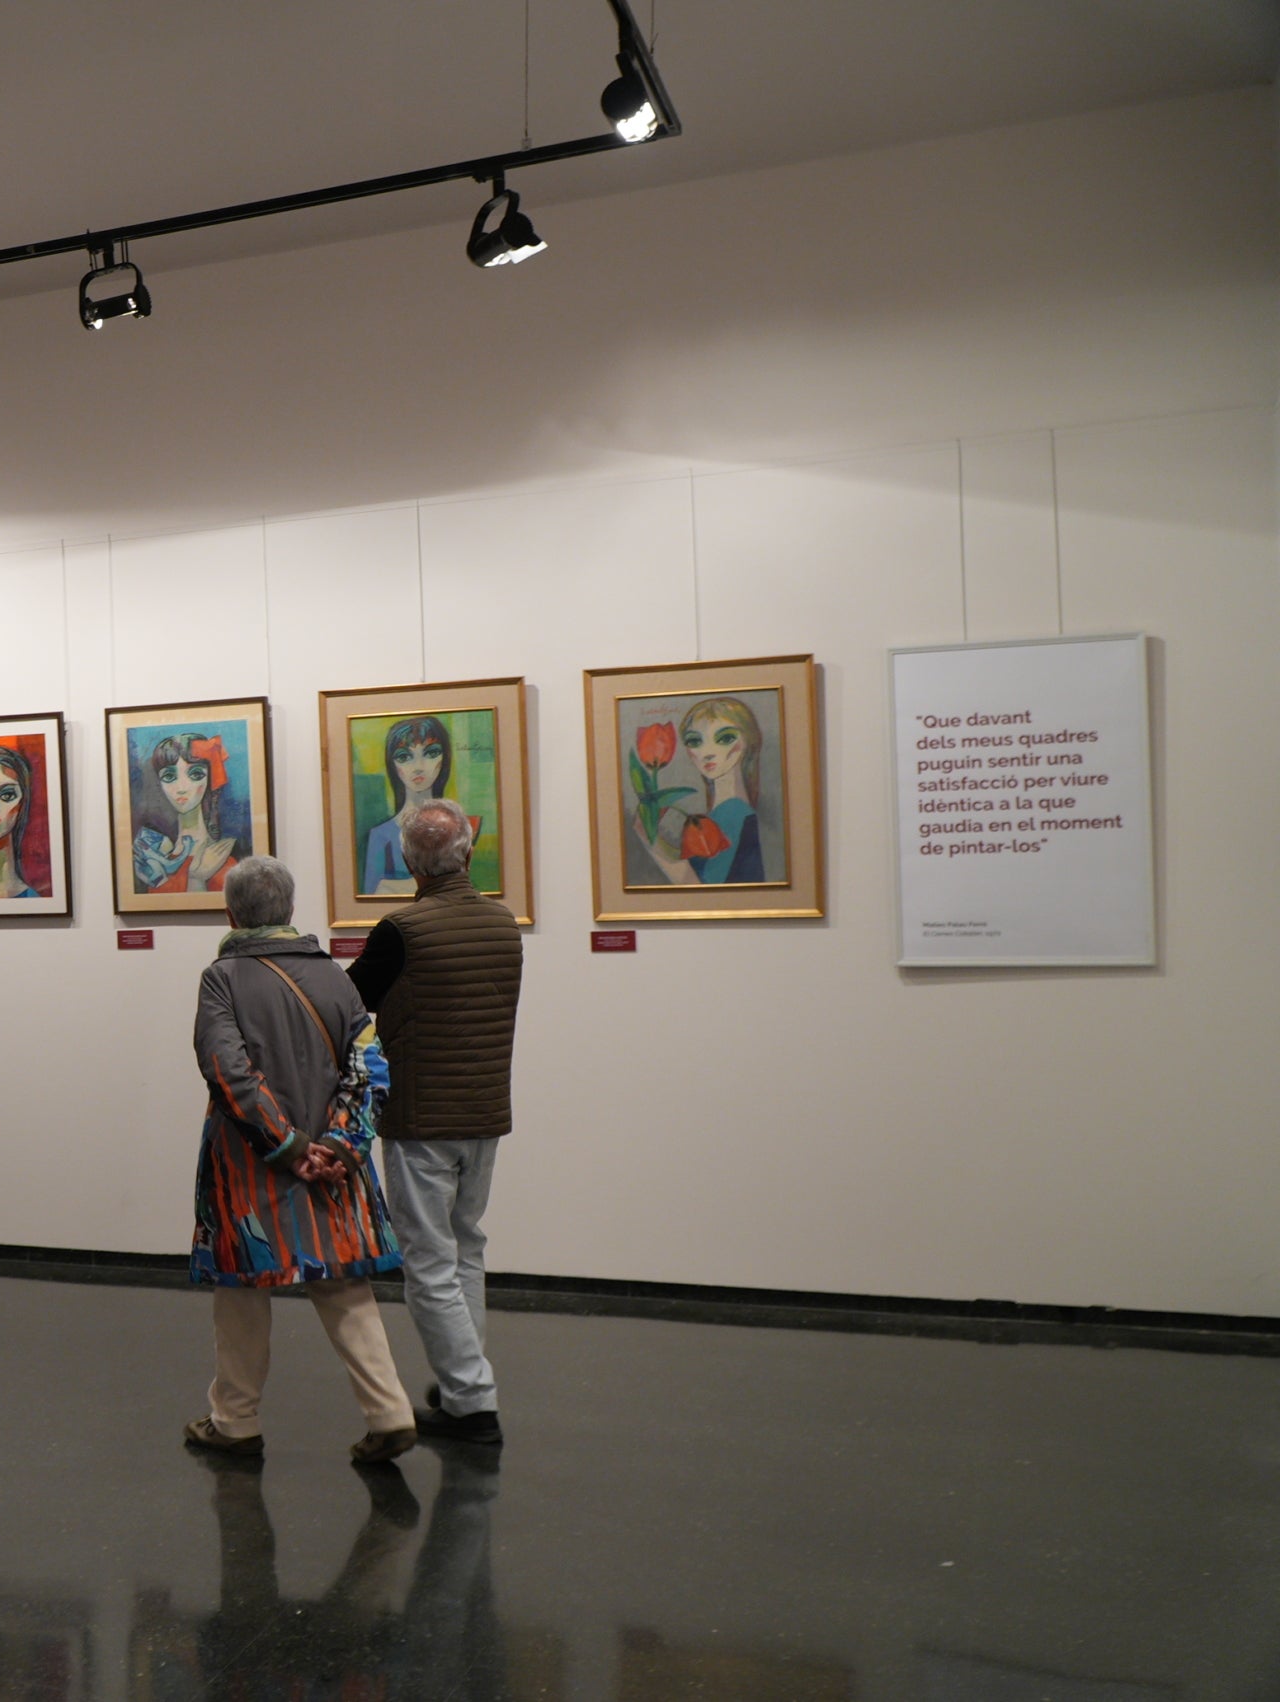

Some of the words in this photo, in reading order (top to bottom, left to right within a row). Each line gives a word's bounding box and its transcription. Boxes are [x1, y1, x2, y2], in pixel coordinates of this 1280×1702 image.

[966, 710, 1032, 728] davant
[916, 735, 956, 750] dels
[961, 734, 1014, 749] meus
[1018, 729, 1099, 748] quadres
[917, 755, 982, 775] puguin
[988, 753, 1042, 769] sentir
[1047, 753, 1083, 767] una
[918, 774, 1018, 793] satisfacció
[1024, 775, 1056, 792] per
[1060, 772, 1109, 787] viure
[918, 798, 994, 814] idèntica
[999, 799, 1010, 812] a
[1015, 796, 1033, 810] la
[1038, 797, 1076, 813] que
[919, 818, 983, 838] gaudia
[988, 820, 1012, 832] en
[1017, 817, 1036, 832] el
[1040, 814, 1124, 831] moment
[920, 840, 944, 856] de
